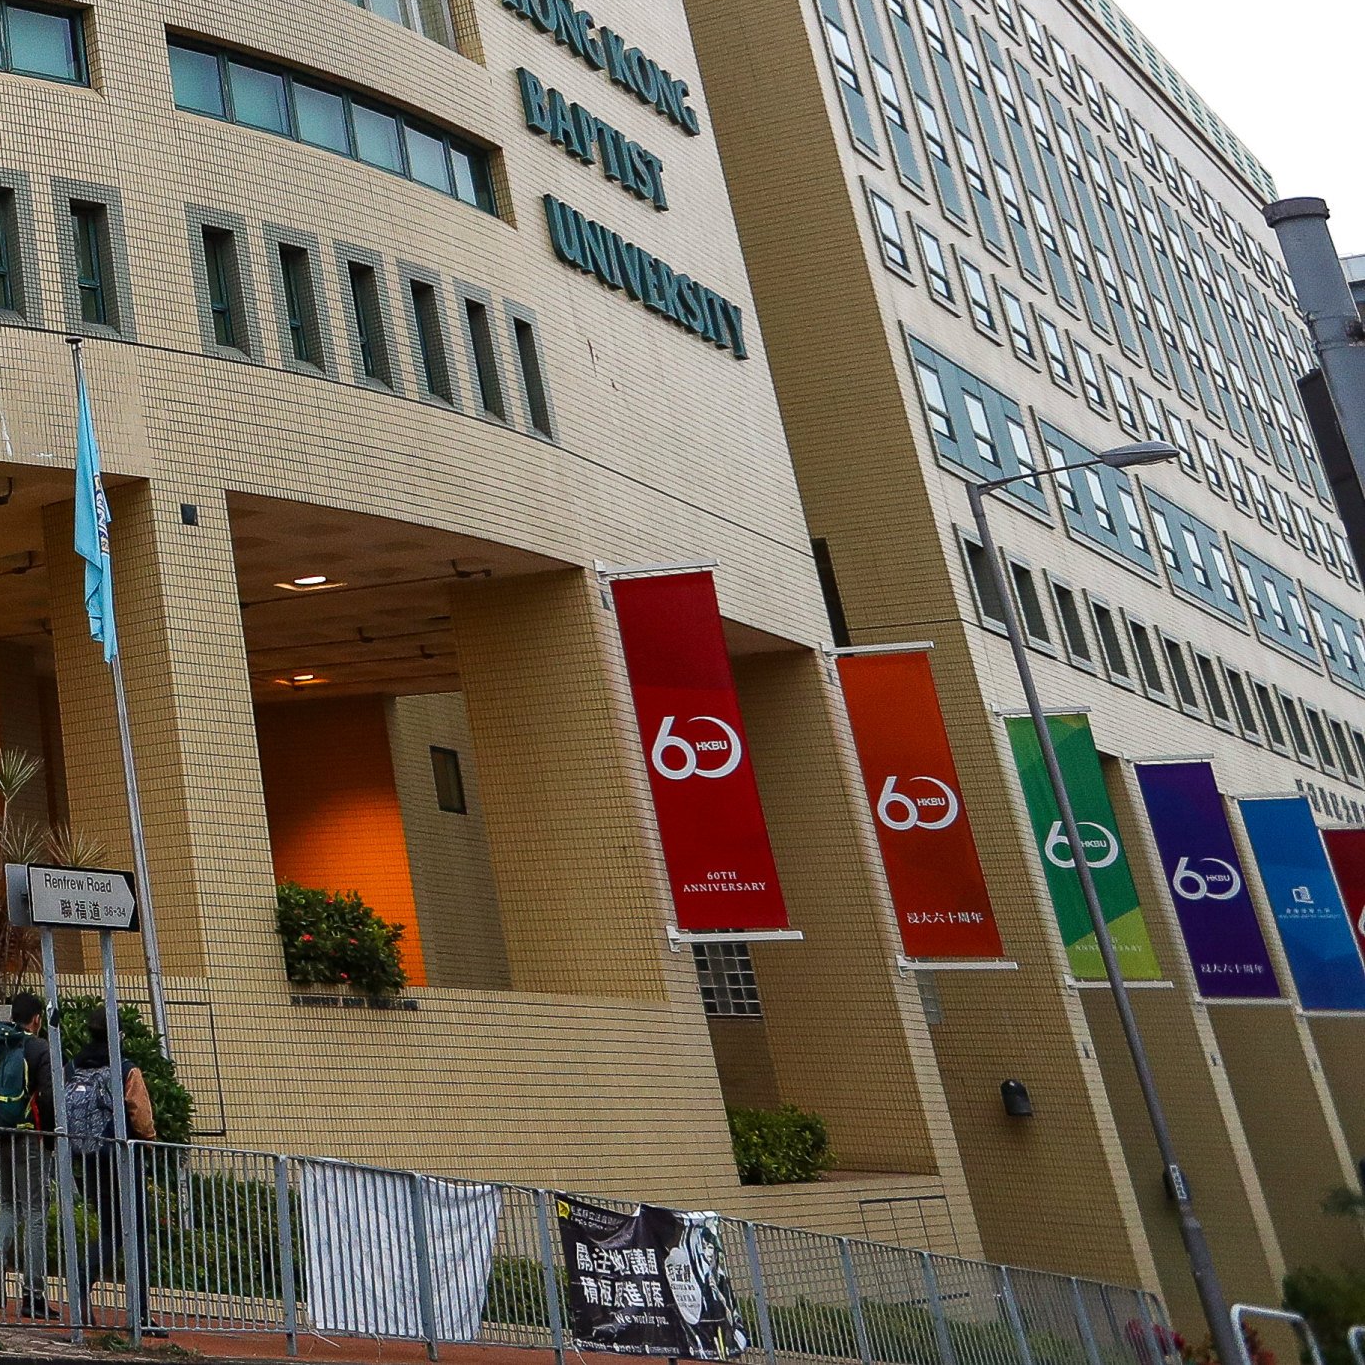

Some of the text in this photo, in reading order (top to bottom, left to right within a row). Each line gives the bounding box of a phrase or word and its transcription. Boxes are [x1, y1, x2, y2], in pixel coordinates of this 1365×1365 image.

[600, 26, 700, 136] KONG
[516, 66, 669, 211] BAPTIST
[542, 193, 748, 361] UNIVERSITY
[652, 716, 742, 780] 60
[696, 741, 727, 751] HKBU
[877, 776, 958, 830] 60
[917, 797, 946, 806] HKBU
[44, 873, 112, 893] Renfrew Road
[706, 871, 737, 880] 60TH
[1173, 857, 1241, 900] 60
[1206, 874, 1231, 882] HKBU
[683, 882, 766, 892] ANNIVERSARY
[60, 899, 101, 921] 聯福道
[907, 912, 984, 924] 浸大六十周年
[614, 1312, 632, 1324] We
